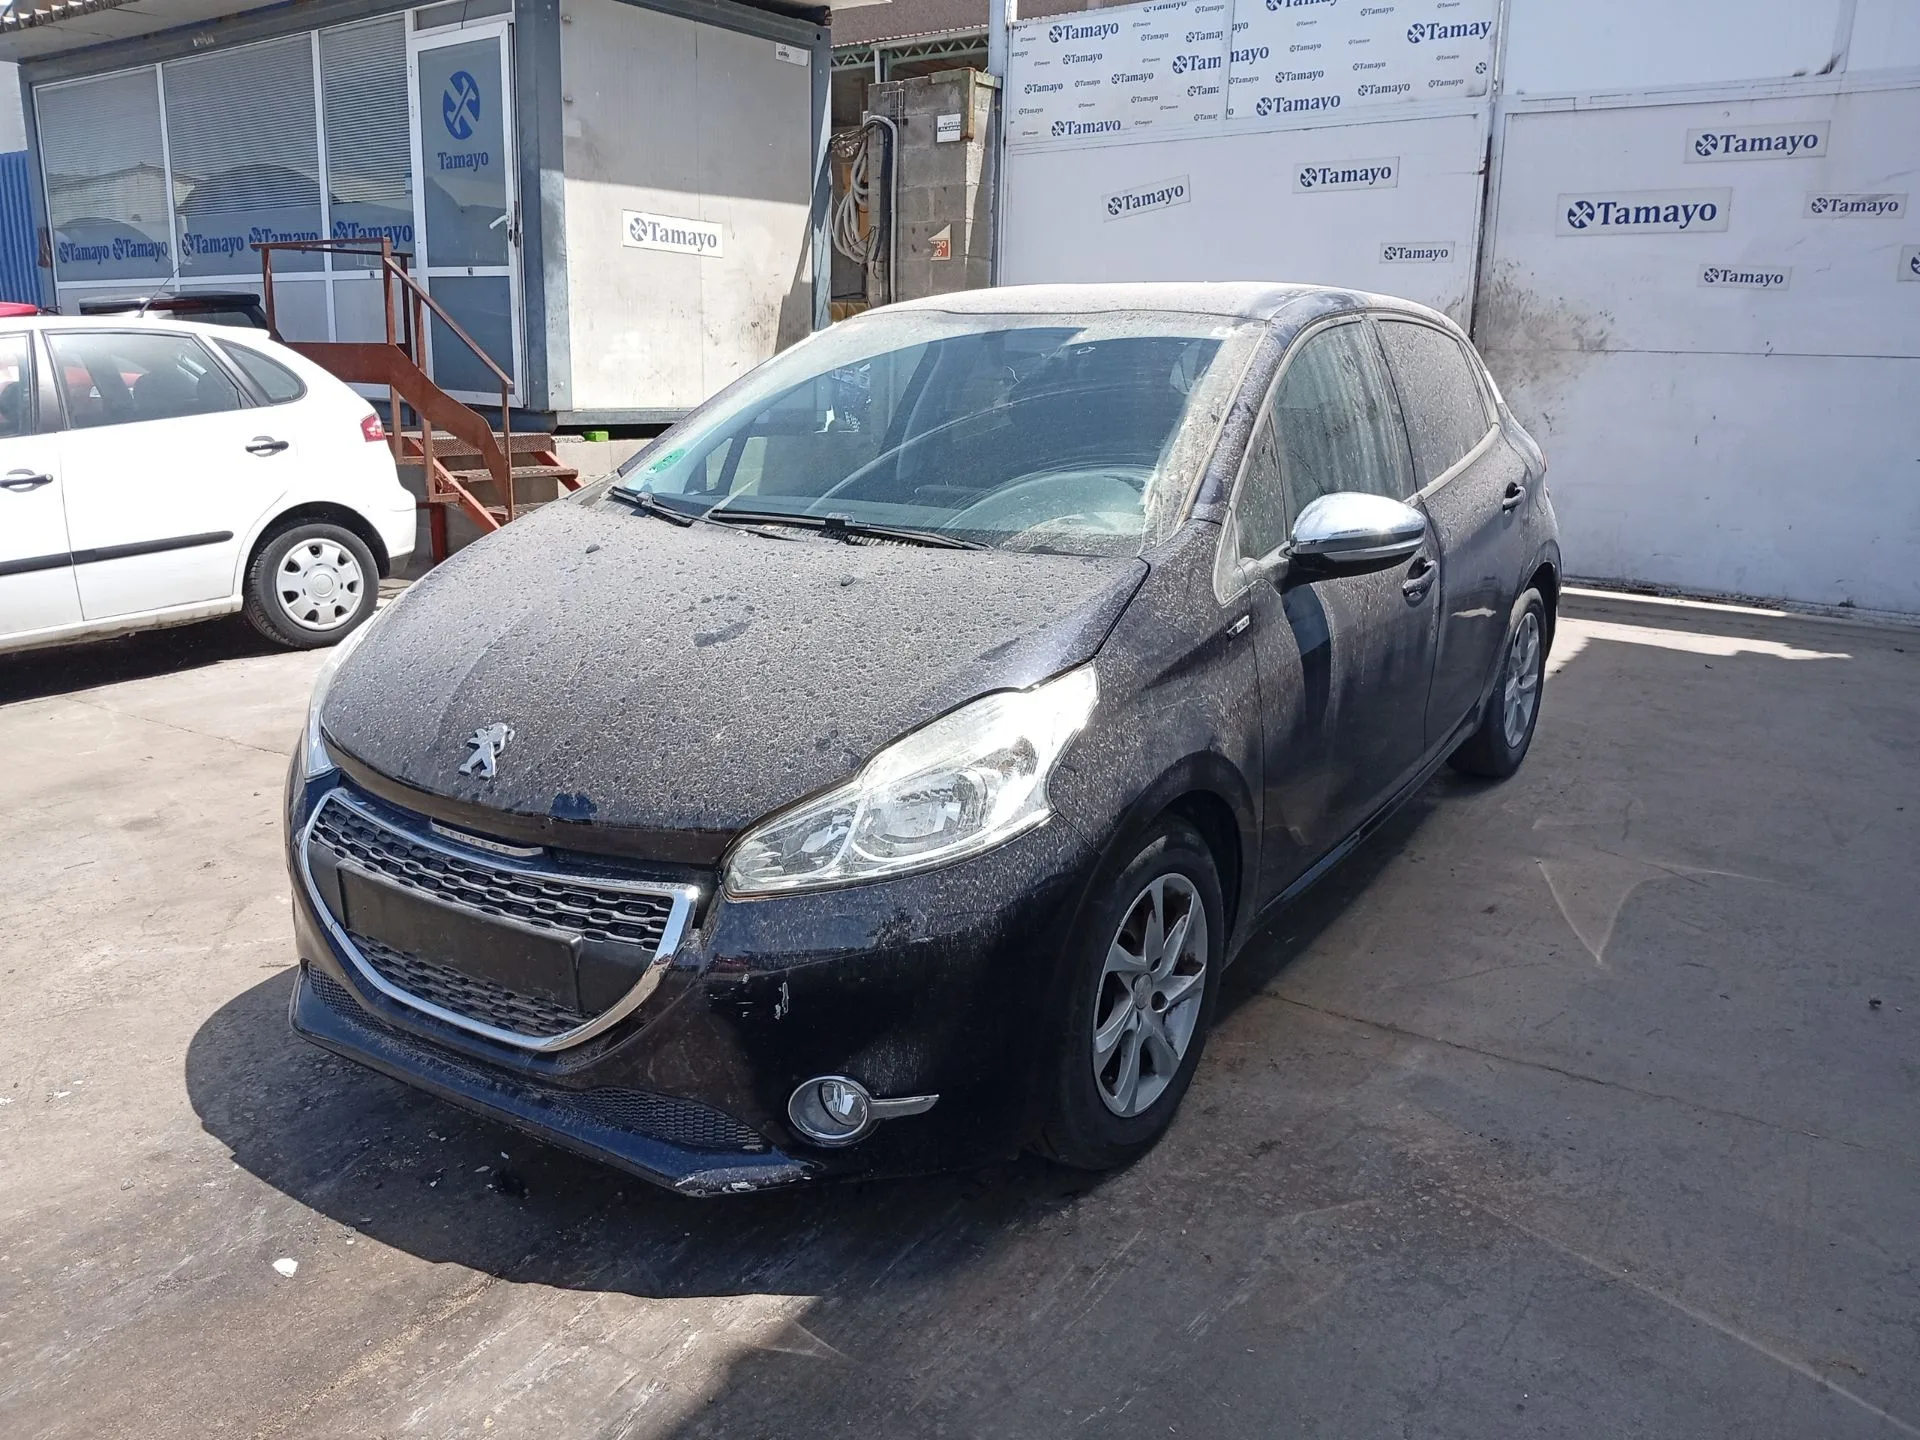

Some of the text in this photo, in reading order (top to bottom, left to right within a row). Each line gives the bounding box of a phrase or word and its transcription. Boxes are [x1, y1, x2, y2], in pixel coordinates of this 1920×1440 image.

[1201, 4, 1224, 12] Tamayo
[1366, 6, 1394, 15] Tamayo
[1063, 22, 1119, 40] Tamayo
[1147, 32, 1169, 41] Tamayo
[1427, 20, 1492, 40] Tamay
[1296, 43, 1321, 52] Tamayo
[1071, 53, 1103, 63] Tamayo
[1359, 61, 1386, 71] Tamayo
[1120, 72, 1154, 83] Tamayo
[1234, 76, 1259, 84] Tamayo
[1285, 69, 1324, 81] Tamayo
[1436, 78, 1464, 88] Tamayo
[1032, 83, 1063, 93] Tamayo
[1368, 82, 1411, 95] Tamayo
[1273, 95, 1341, 113] Tamayo
[1720, 133, 1819, 156] Tamayo
[438, 150, 489, 172] Tamayo
[1317, 165, 1391, 185] Tamayo
[1122, 184, 1184, 212] Tamayo
[1829, 198, 1899, 216] Tamayo
[1598, 201, 1718, 229] Tamayo
[348, 221, 413, 249] Tamayo
[648, 221, 717, 252] Tamayo
[68, 242, 109, 264] Tamayo
[122, 239, 168, 262] Tamayo
[194, 233, 244, 257] Tamayo
[1397, 246, 1448, 261] Tamayo
[1720, 269, 1784, 287] Tamayo
[440, 827, 509, 854] PEUGEOT
